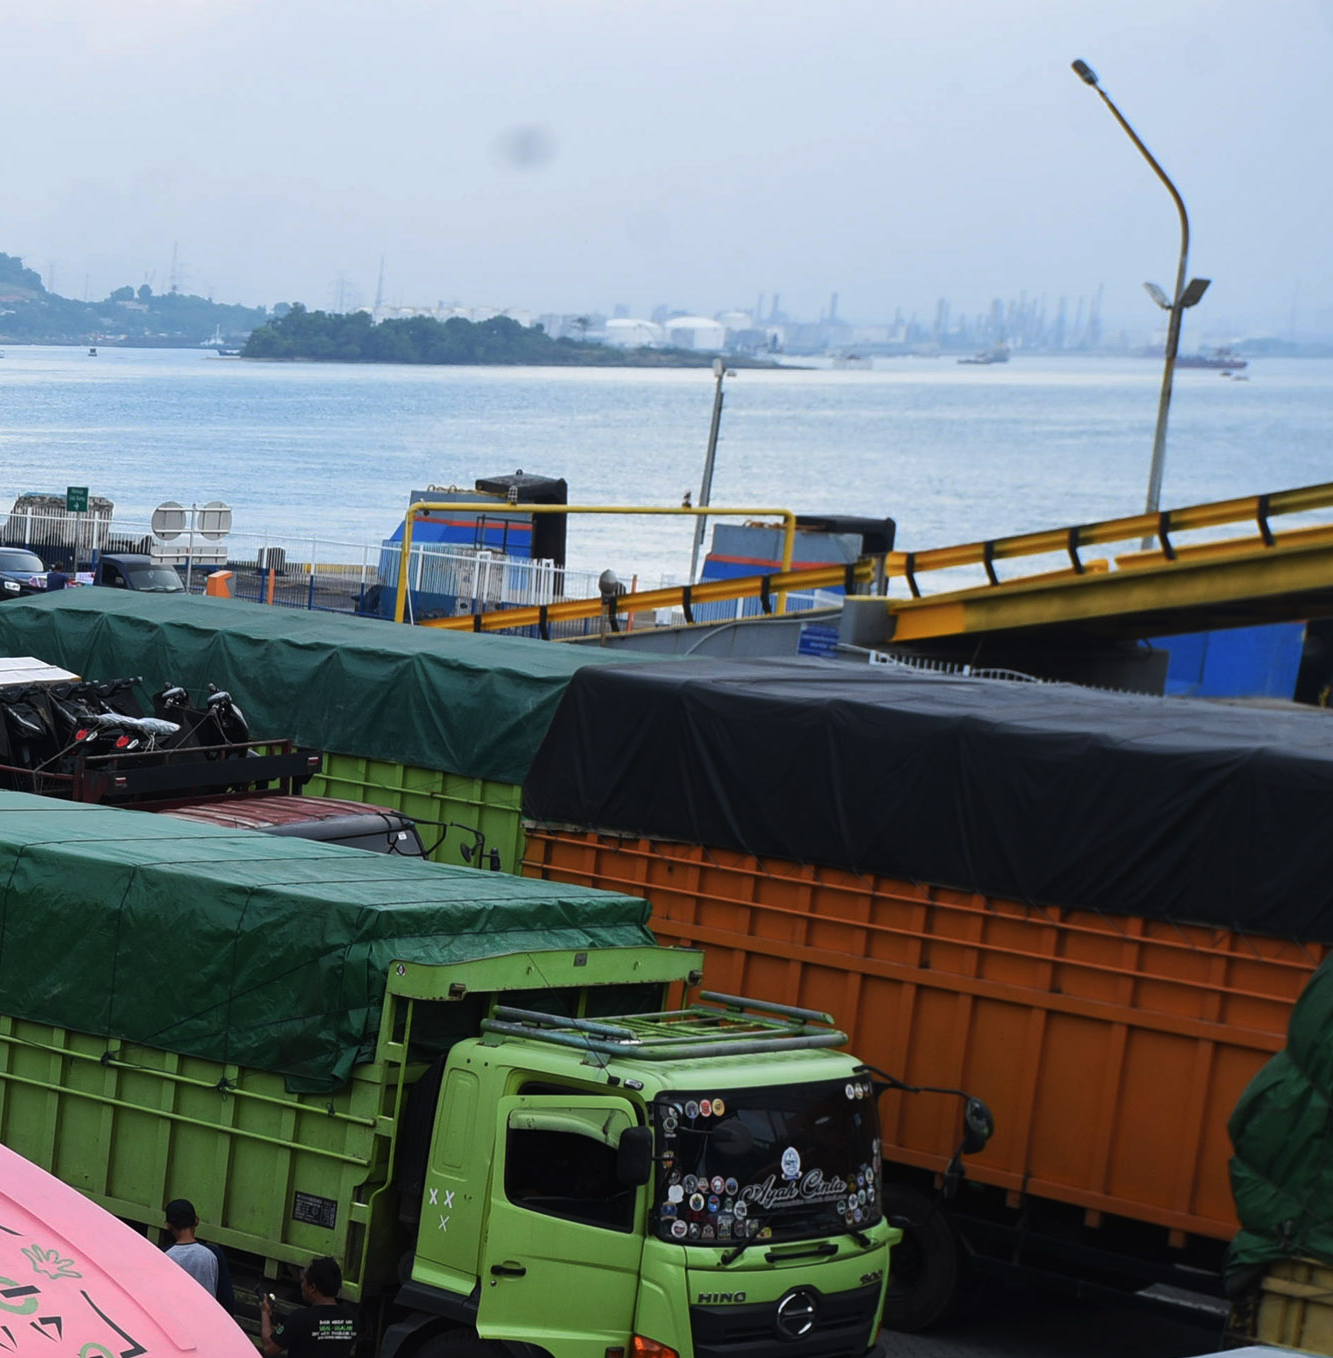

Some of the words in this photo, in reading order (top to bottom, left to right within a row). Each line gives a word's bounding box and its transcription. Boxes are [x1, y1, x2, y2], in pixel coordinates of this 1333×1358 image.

[739, 1174, 800, 1209] Ayah
[799, 1168, 847, 1198] Cinta
[697, 1292, 747, 1303] HINO
